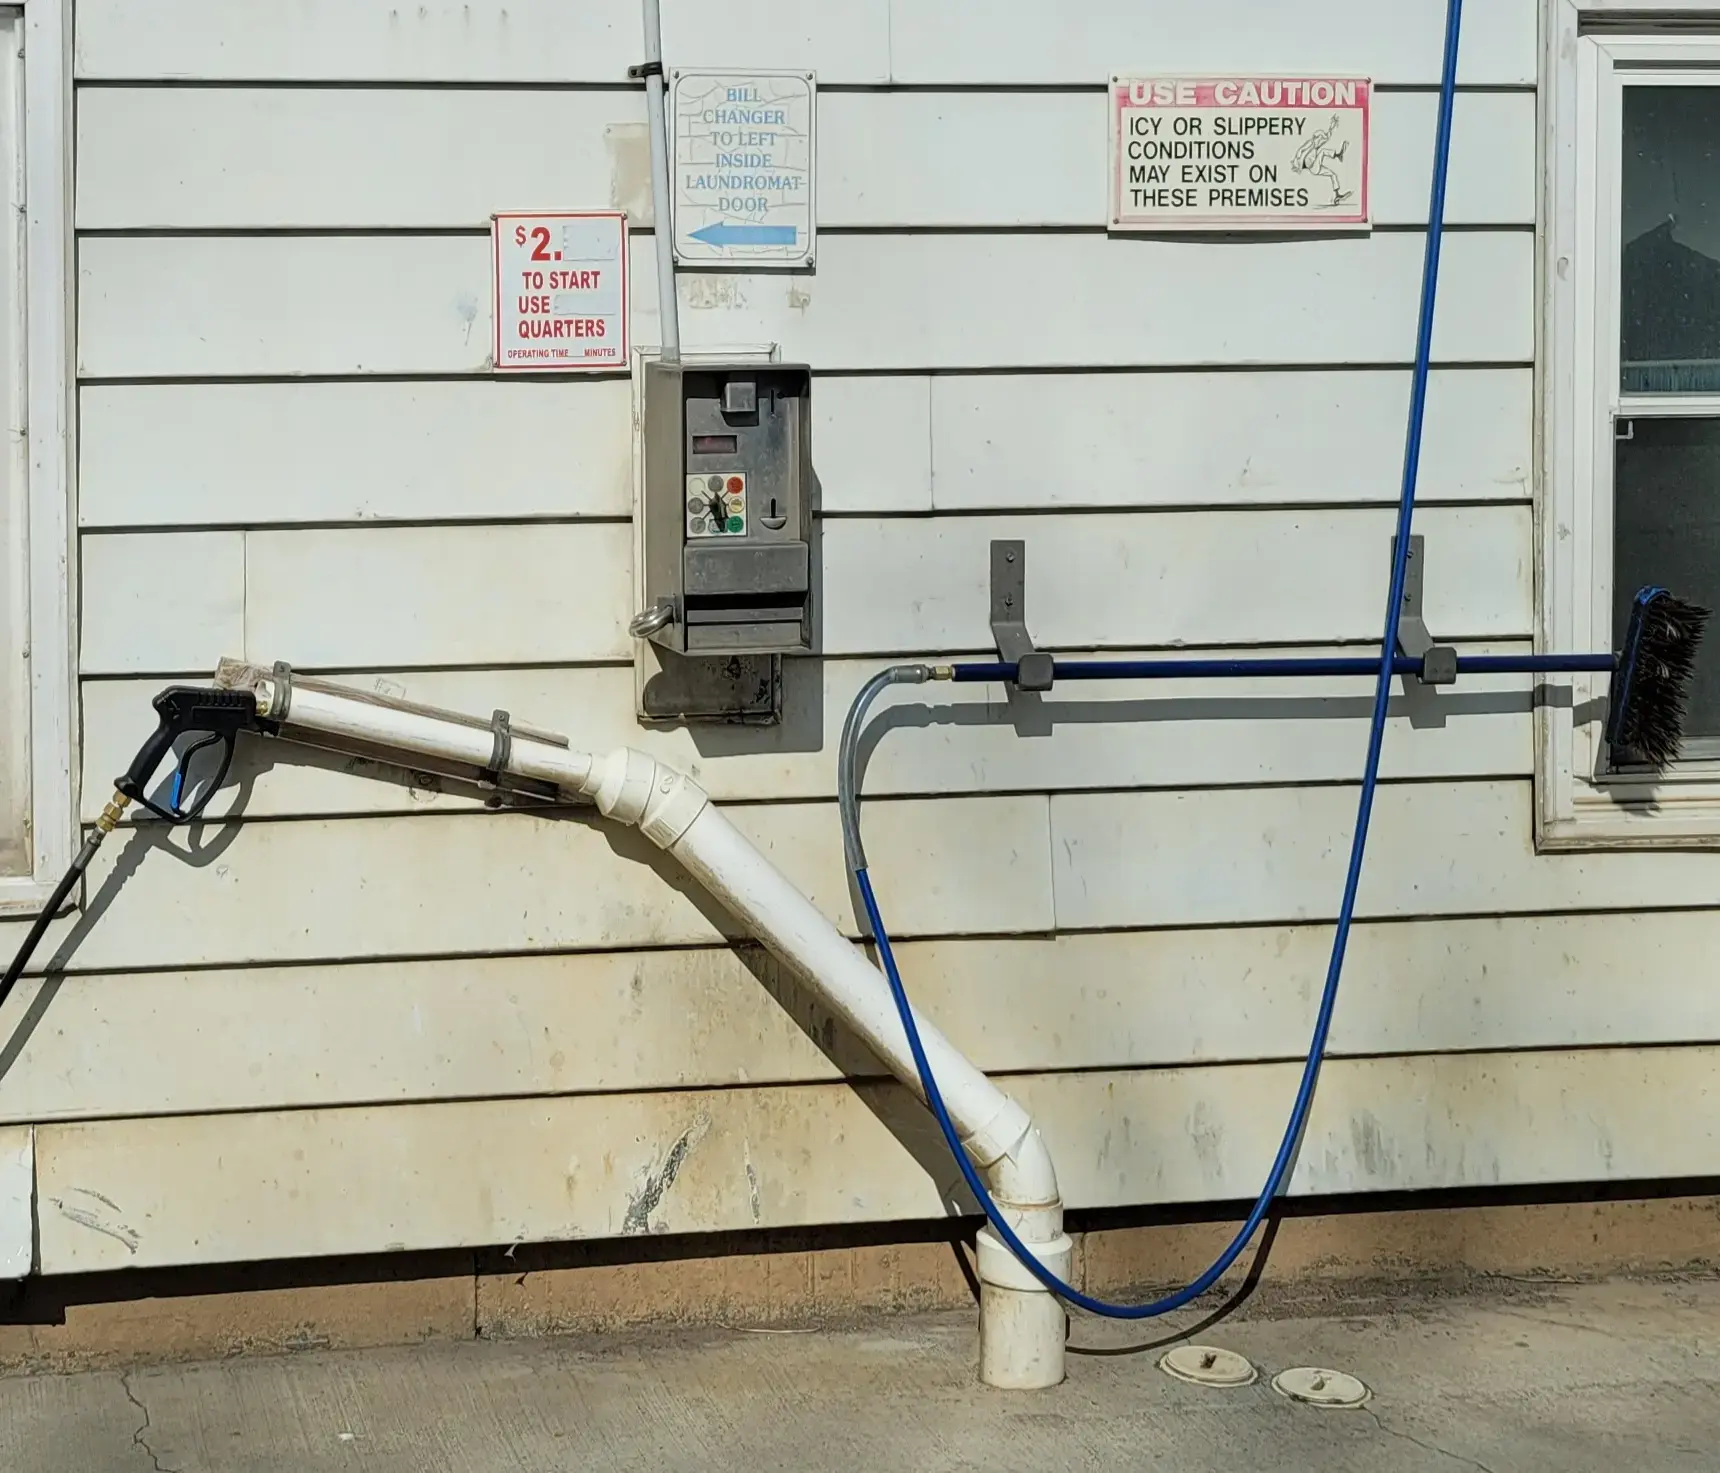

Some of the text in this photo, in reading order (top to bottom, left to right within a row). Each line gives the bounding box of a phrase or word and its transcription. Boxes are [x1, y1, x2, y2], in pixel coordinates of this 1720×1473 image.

[726, 88, 761, 102] BILL
[1127, 80, 1357, 106] USE CAUTION
[703, 110, 785, 125] CHANGER
[1129, 117, 1306, 136] ICY OR SLIPPERY
[710, 131, 777, 146] TO LEFT
[1128, 141, 1255, 160] CONDITIONS
[715, 153, 772, 168] INSIDE
[686, 175, 802, 190] LAUNDROMAT
[1129, 165, 1277, 184] MAY EXIST ON
[718, 197, 769, 212] DOOR
[1130, 188, 1309, 207] THESE PREMISES
[522, 270, 601, 290] TO START
[518, 296, 550, 314] USE
[518, 319, 605, 339] QUARTERS
[507, 347, 616, 359] OPERATING TIME MINUTES
